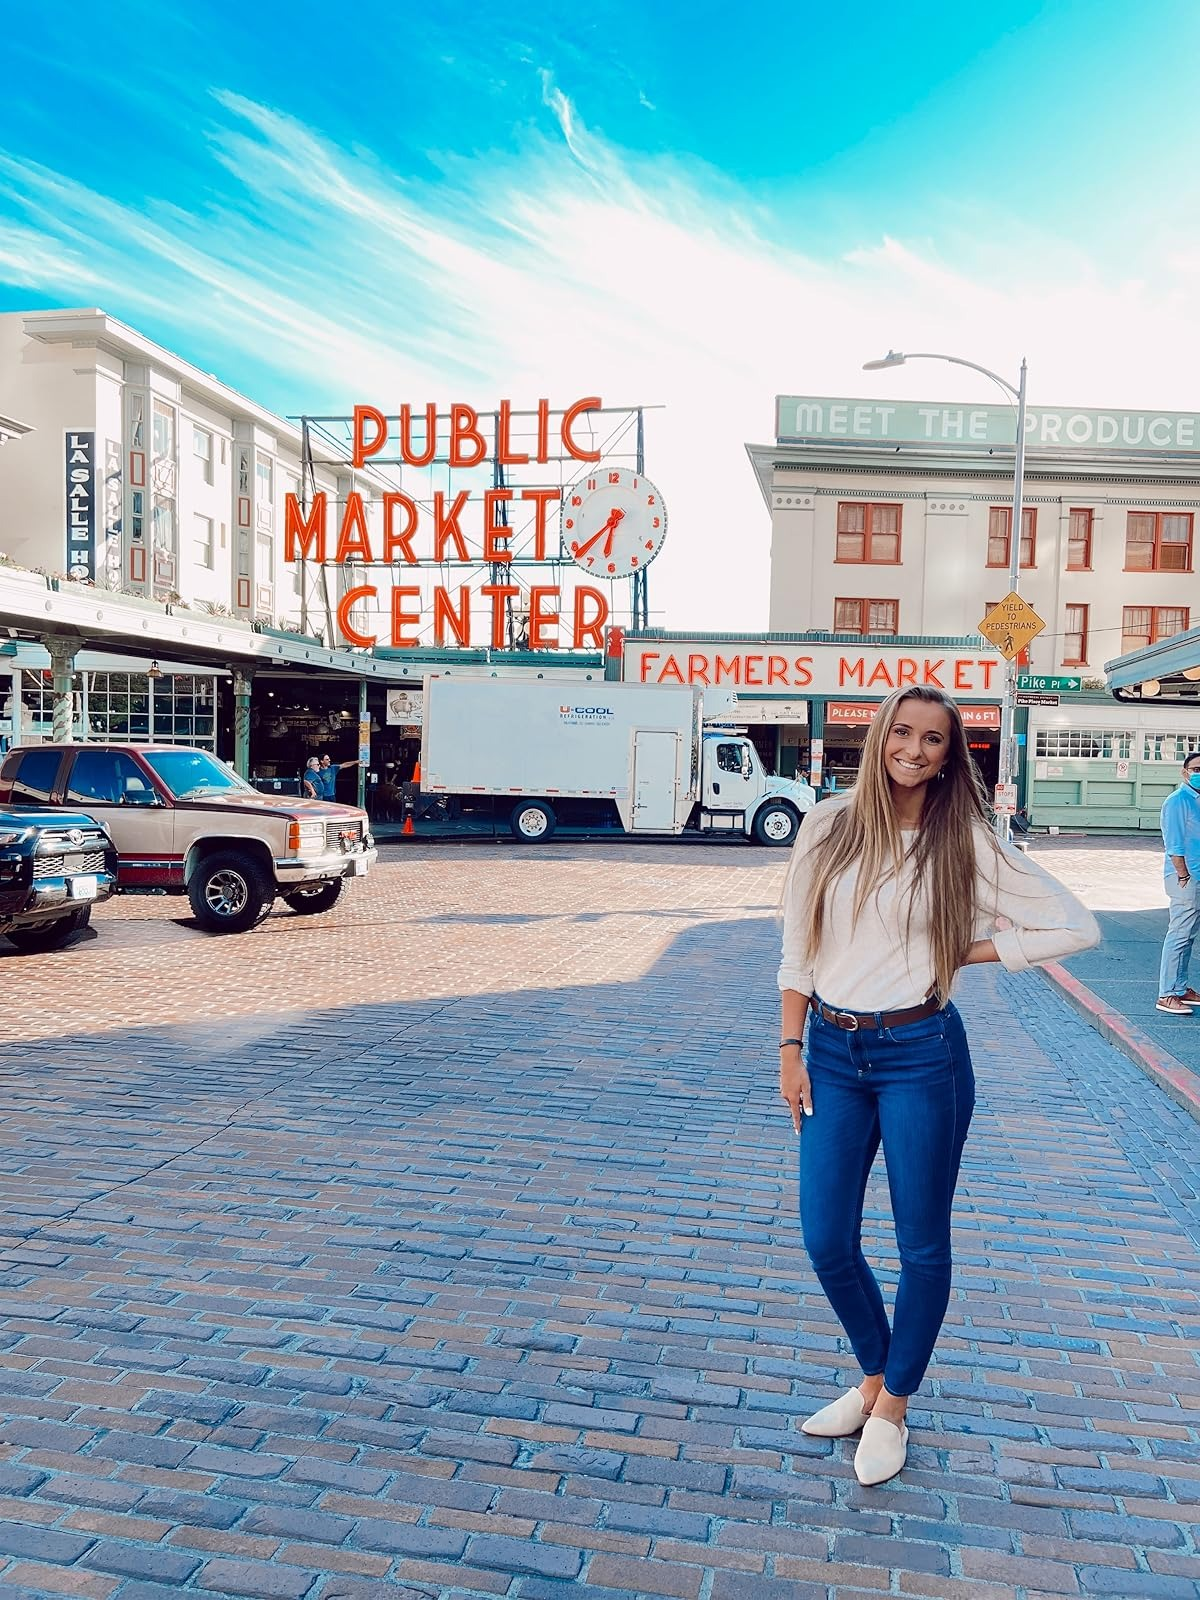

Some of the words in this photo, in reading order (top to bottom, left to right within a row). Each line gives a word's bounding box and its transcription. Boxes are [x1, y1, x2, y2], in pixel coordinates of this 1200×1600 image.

[796, 403, 896, 436] MEET
[919, 408, 988, 440] THE
[1024, 413, 1195, 446] PRODUCE
[353, 396, 602, 468] PUBLIC
[587, 478, 596, 490] 11
[608, 472, 619, 484] 12
[633, 478, 638, 489] 1
[571, 495, 582, 507] 10
[647, 494, 655, 505] 2
[284, 489, 561, 563] MARKET
[565, 518, 574, 529] 9
[652, 517, 660, 528] 3
[570, 541, 579, 552] 8
[644, 539, 654, 551] 4
[586, 556, 595, 568] 7
[607, 562, 616, 573] 6
[630, 556, 638, 567] 5
[1001, 603, 1024, 612] YIELD
[337, 585, 609, 649] CENTER
[1007, 613, 1017, 621] TO
[986, 622, 1037, 631] PEDESTRIANS
[640, 652, 814, 687] FARMERS
[839, 656, 998, 690] MARKET
[1021, 676, 1046, 689] Pike
[560, 705, 615, 714] U-COOL
[832, 708, 869, 718] PLEASE
[975, 712, 982, 721] 6
[983, 711, 996, 721] FT
